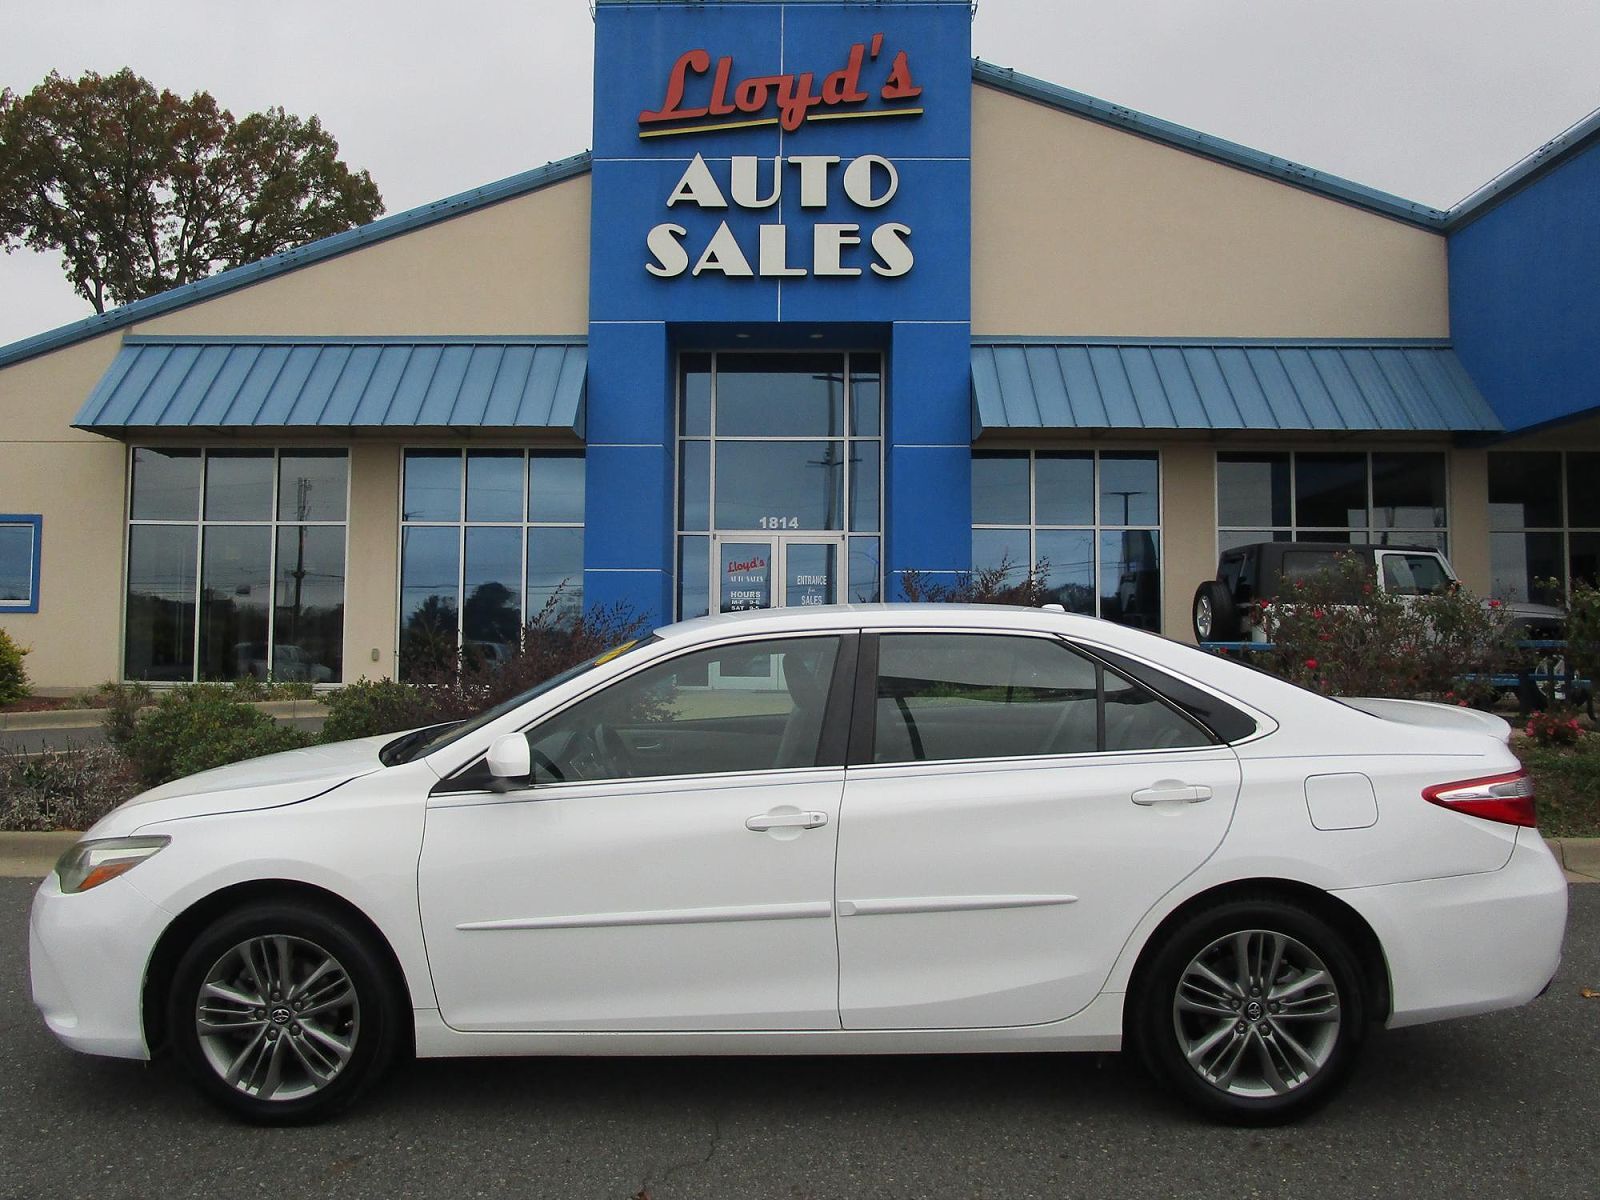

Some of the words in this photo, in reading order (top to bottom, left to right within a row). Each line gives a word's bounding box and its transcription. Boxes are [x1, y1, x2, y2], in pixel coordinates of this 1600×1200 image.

[638, 32, 923, 132] Lloyd's
[666, 152, 899, 208] AUTO
[645, 220, 914, 278] SALES
[759, 516, 799, 529] 1814
[728, 556, 766, 573] Lloyd's
[797, 575, 827, 585] ENTRANCE
[801, 595, 823, 606] SALES
